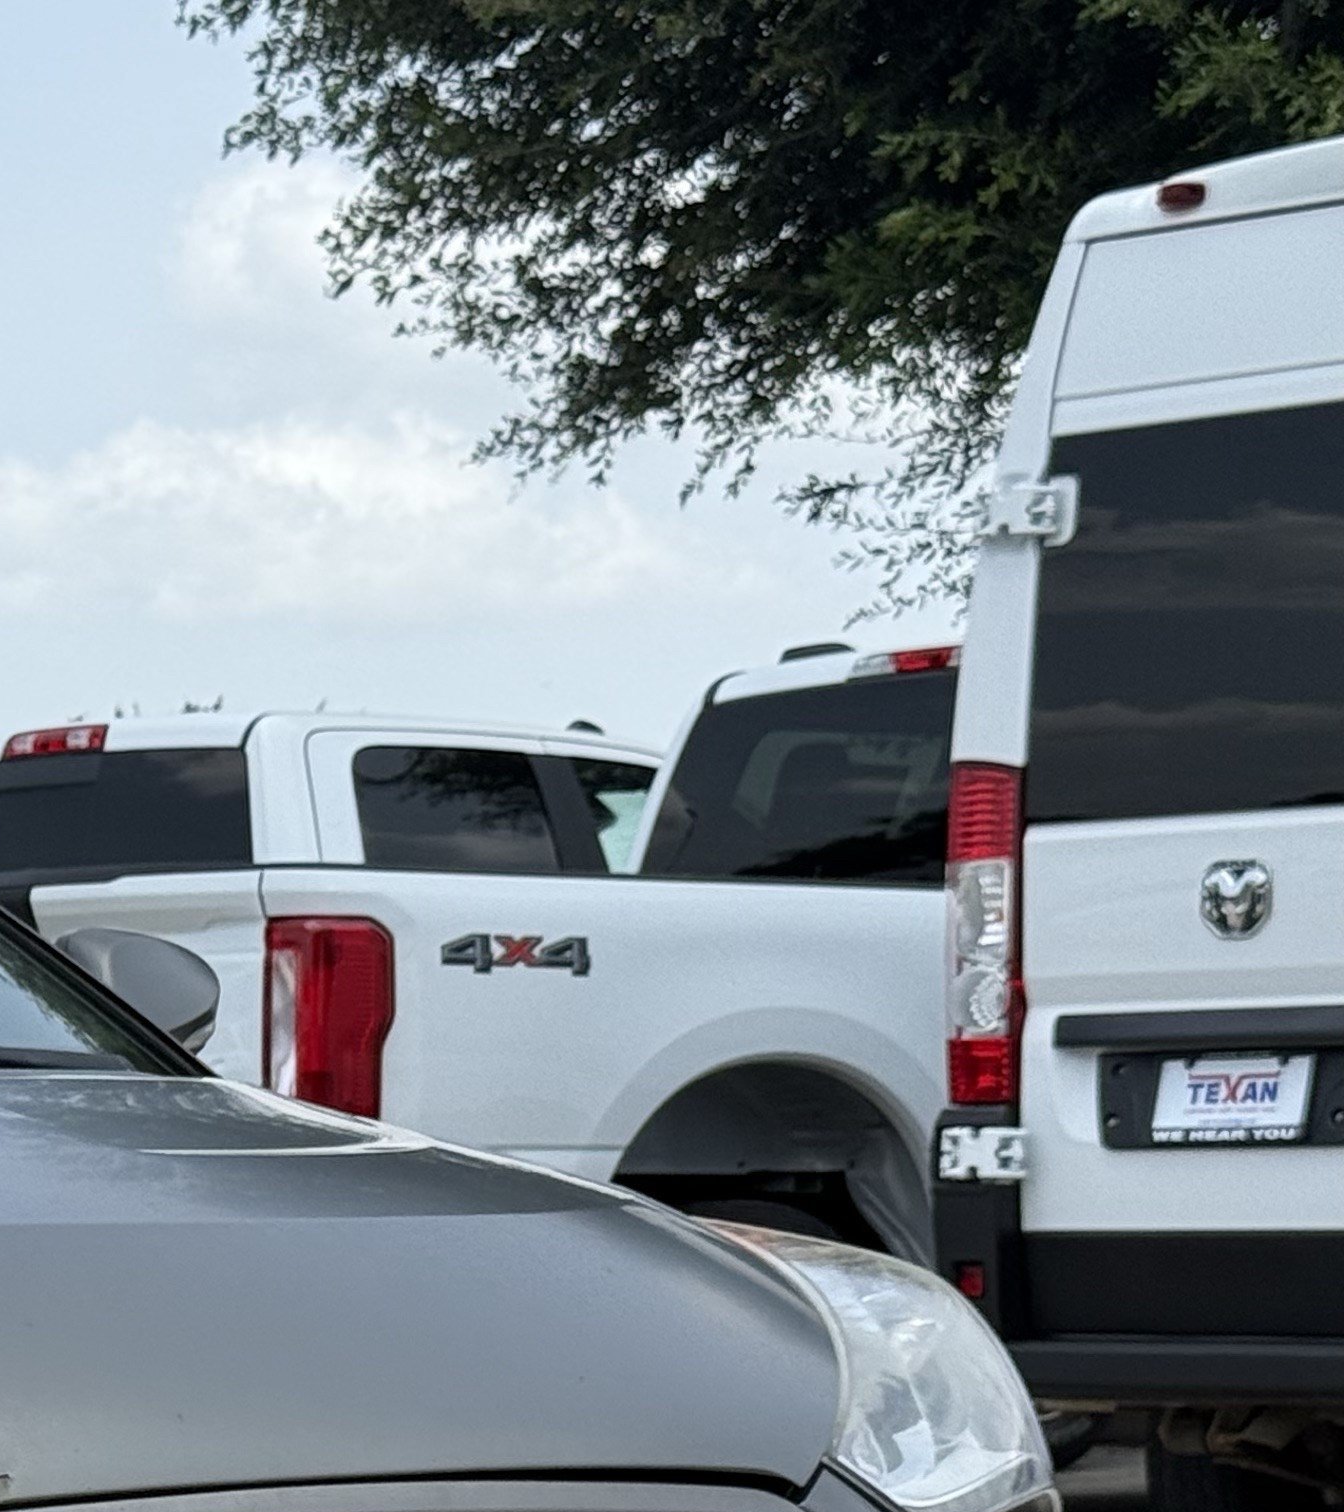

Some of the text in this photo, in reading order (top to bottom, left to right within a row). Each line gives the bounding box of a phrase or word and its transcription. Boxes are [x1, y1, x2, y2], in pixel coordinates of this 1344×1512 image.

[1187, 1072, 1280, 1105] TEXAN
[1152, 1128, 1296, 1142] WE HEAR YOU
